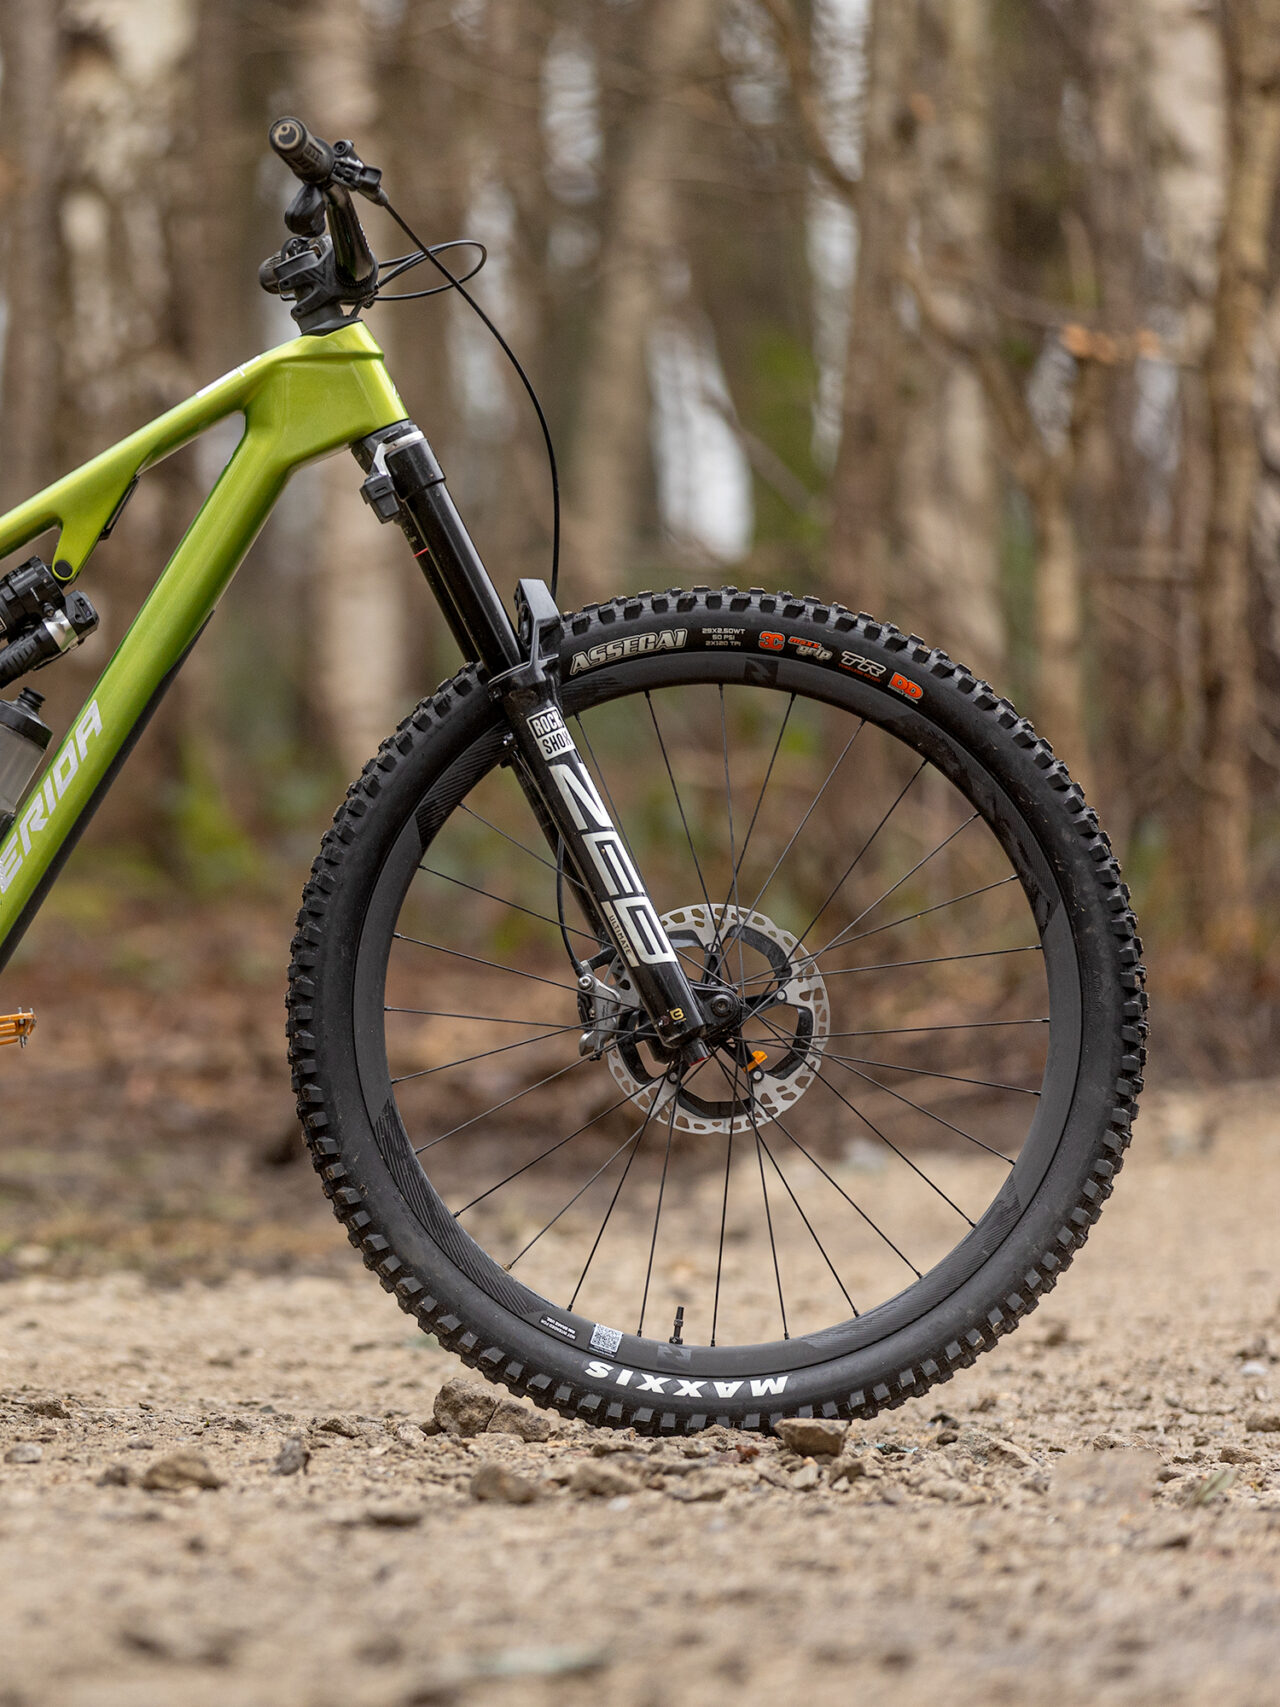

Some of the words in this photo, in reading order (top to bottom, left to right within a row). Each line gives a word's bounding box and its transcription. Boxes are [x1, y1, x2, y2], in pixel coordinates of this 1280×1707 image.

[570, 628, 688, 676] ASSEGAI
[758, 630, 785, 651] 3C
[796, 645, 833, 660] grip
[841, 650, 887, 677] TR
[889, 671, 924, 699] DD
[532, 710, 563, 736] ROCK
[542, 730, 571, 754] SHOX
[548, 763, 679, 965] ZEB
[609, 914, 632, 954] ULTIMATE
[584, 1360, 789, 1399] MAXXIS
